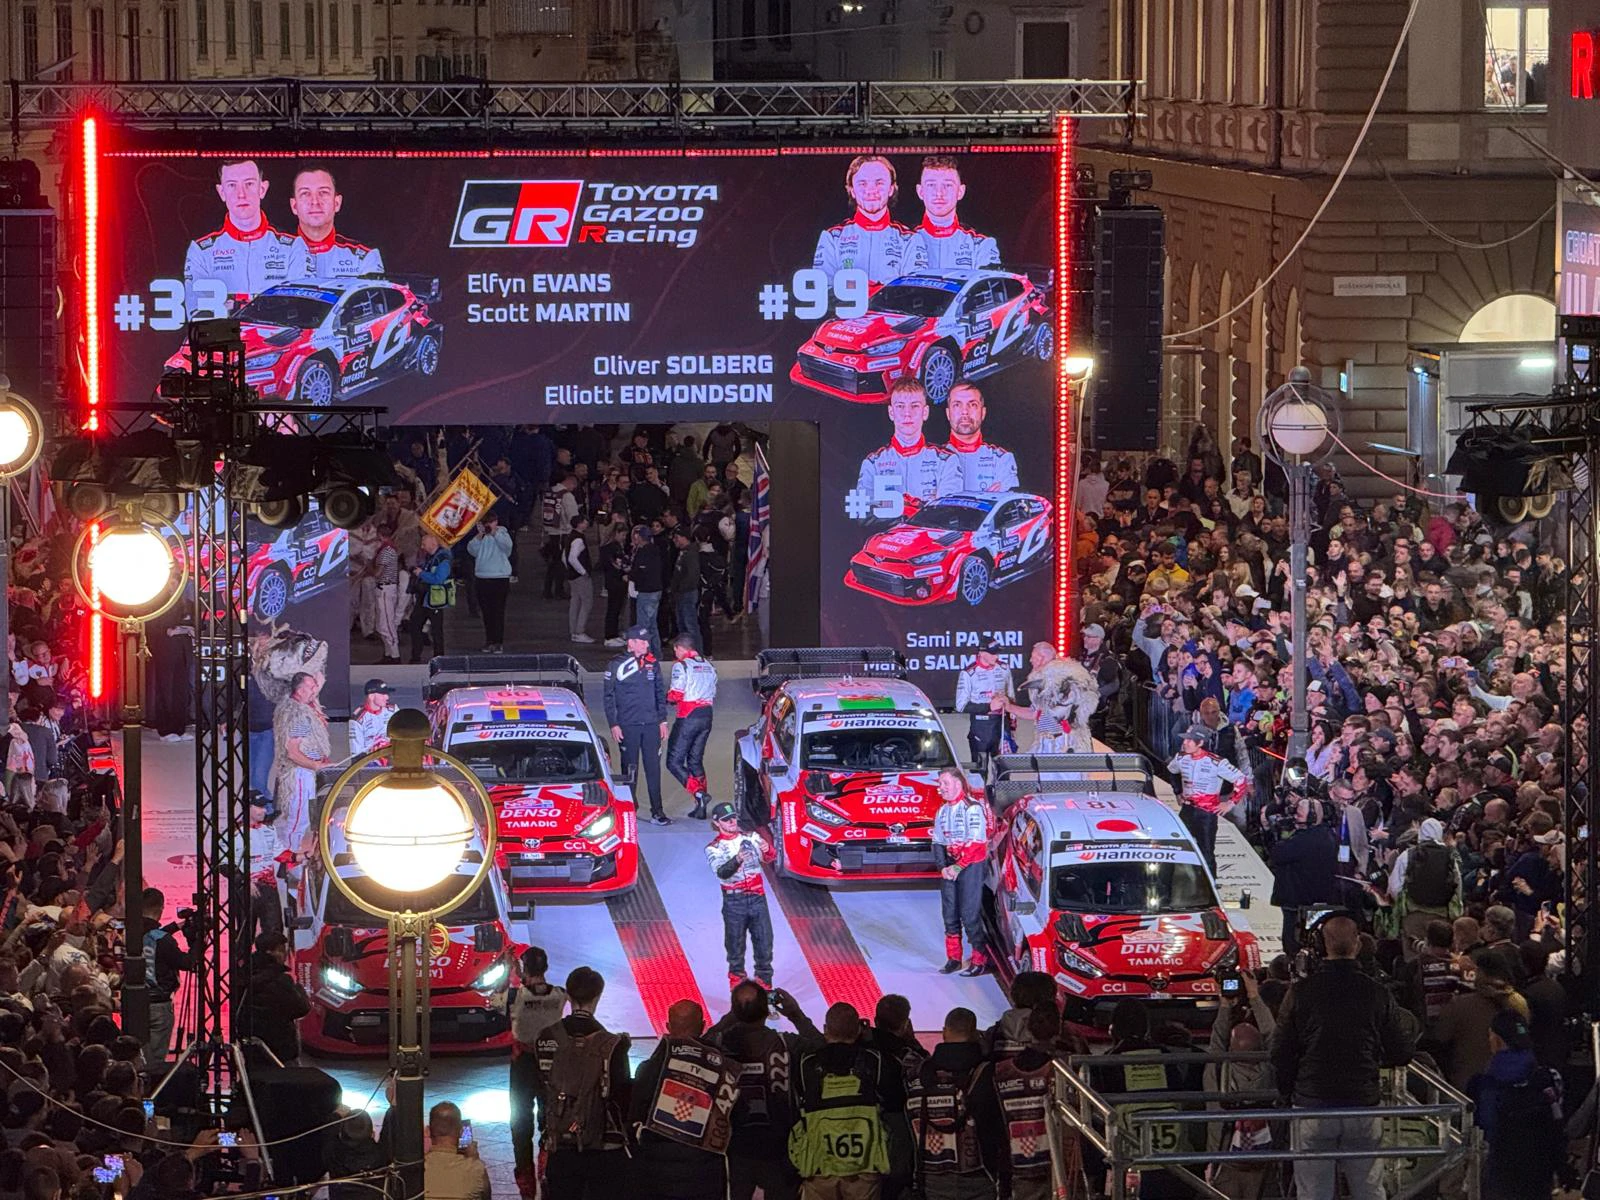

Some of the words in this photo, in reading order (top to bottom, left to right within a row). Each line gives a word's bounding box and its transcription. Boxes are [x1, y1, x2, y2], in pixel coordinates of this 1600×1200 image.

[588, 183, 719, 201] TOYOTA
[582, 204, 704, 222] GAZOO
[578, 225, 698, 248] Racing
[467, 273, 526, 297] Elfyn
[532, 273, 612, 293] EVANS
[759, 269, 869, 320] #99
[467, 303, 530, 323] Scott
[536, 303, 631, 322] MARTIN
[974, 343, 989, 357] CCI
[352, 356, 369, 371] CCI
[593, 356, 660, 375] Oliver
[666, 355, 774, 374] SOLBERG
[545, 386, 613, 405] Elliott
[620, 384, 774, 403] EDMONDSON
[845, 475, 905, 519] #5
[906, 631, 951, 648] Sami
[924, 654, 1023, 670] SALMEN
[863, 795, 923, 805] DENSO
[500, 808, 562, 818] DENSO
[844, 829, 867, 838] CCI
[563, 842, 586, 850] CCI
[1121, 944, 1186, 954] DENSO
[1128, 958, 1183, 966] TAMADIC
[1102, 982, 1126, 992] CCI
[1192, 982, 1215, 992] CCI
[672, 1045, 702, 1053] WRC
[690, 1065, 701, 1075] TV
[770, 1052, 789, 1093] 222
[823, 1134, 864, 1158] 165
